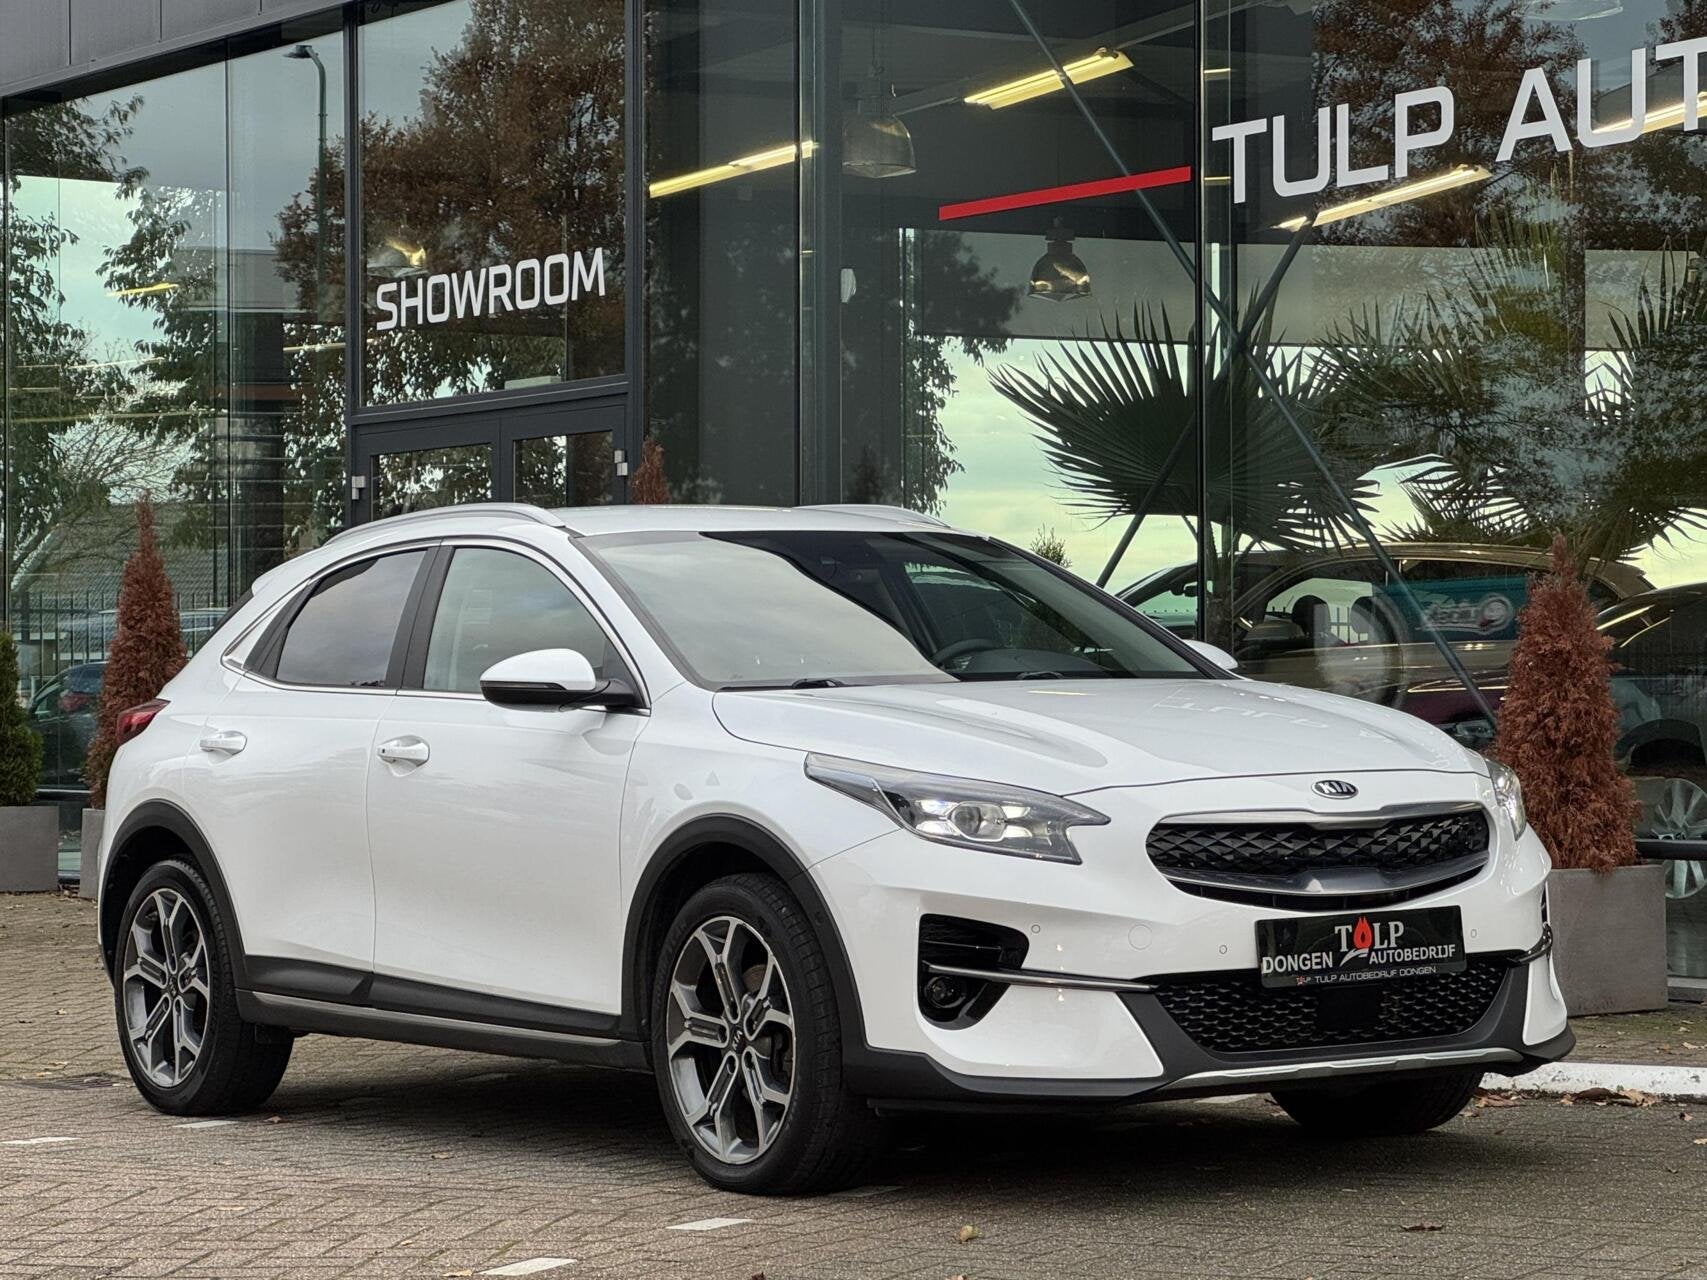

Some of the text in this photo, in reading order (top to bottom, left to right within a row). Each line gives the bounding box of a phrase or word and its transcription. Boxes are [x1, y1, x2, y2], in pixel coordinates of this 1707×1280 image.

[1212, 37, 1707, 204] TULP AUT
[376, 247, 606, 330] SHOWROOM
[1316, 781, 1355, 794] KIA
[1262, 952, 1333, 974] DONGEN
[1369, 944, 1456, 965] AUTOBEDRIJF
[1314, 967, 1437, 984] TULP AUTOBEDRIJF DONGEN
